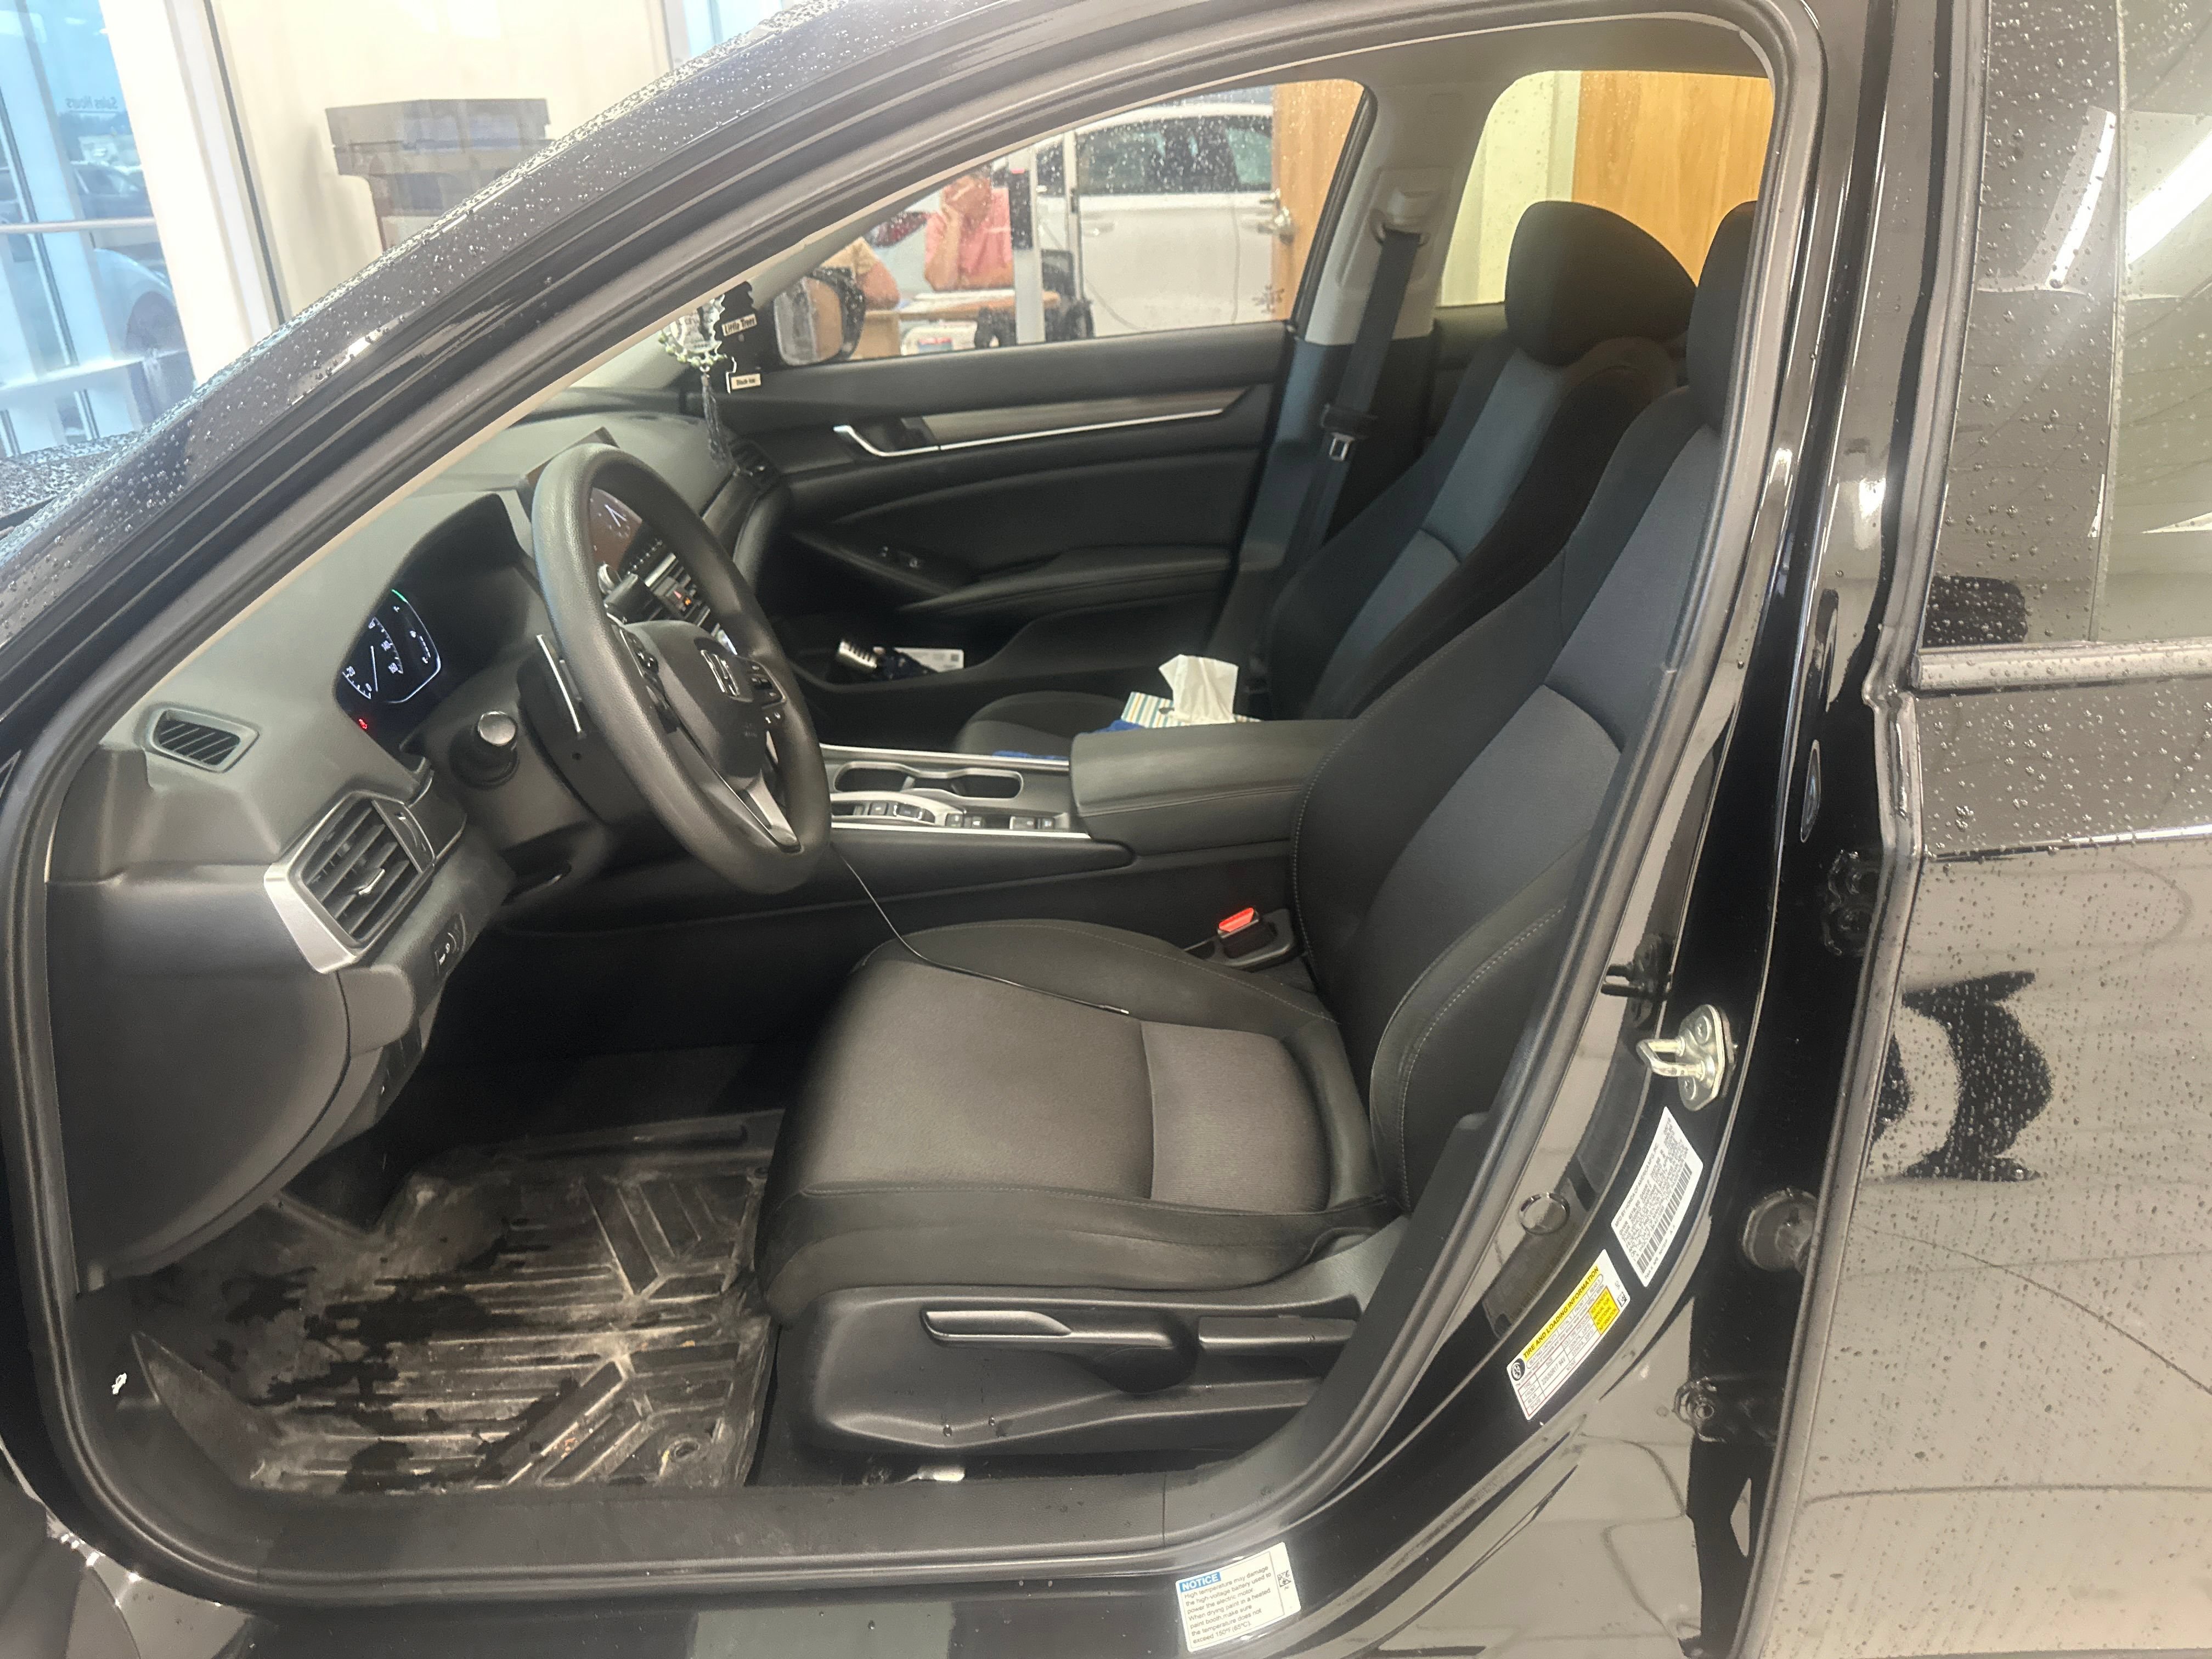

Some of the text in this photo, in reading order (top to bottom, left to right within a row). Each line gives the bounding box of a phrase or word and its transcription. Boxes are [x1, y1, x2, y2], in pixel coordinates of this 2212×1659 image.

[724, 317, 755, 335] Little Trees
[1625, 1192, 1635, 1210] HONDA
[1634, 1184, 1639, 1194] OF
[1638, 1164, 1649, 1187] AMERICA
[1524, 1266, 1598, 1358] TIRE AND LOADING INFORMATION
[1530, 1333, 1556, 1364] SEATING CAPACITY
[1182, 1573, 1217, 1590] NOTICE
[1197, 1589, 1229, 1602] high-voltage
[1232, 1581, 1250, 1592] battery
[1252, 1575, 1264, 1583] used
[1200, 1581, 1232, 1594] temperature
[1247, 1566, 1267, 1577] damage
[1188, 1605, 1204, 1614] power
[1217, 1595, 1235, 1604] electric
[1189, 1613, 1205, 1621] When
[1207, 1607, 1223, 1616] drying
[1226, 1601, 1238, 1610] paint
[1252, 1588, 1269, 1599] heated
[1190, 1621, 1203, 1629] paint
[1223, 1609, 1238, 1618] make
[1203, 1619, 1235, 1632] temperature
[1238, 1612, 1250, 1621] does
[1194, 1634, 1213, 1644] exceed
